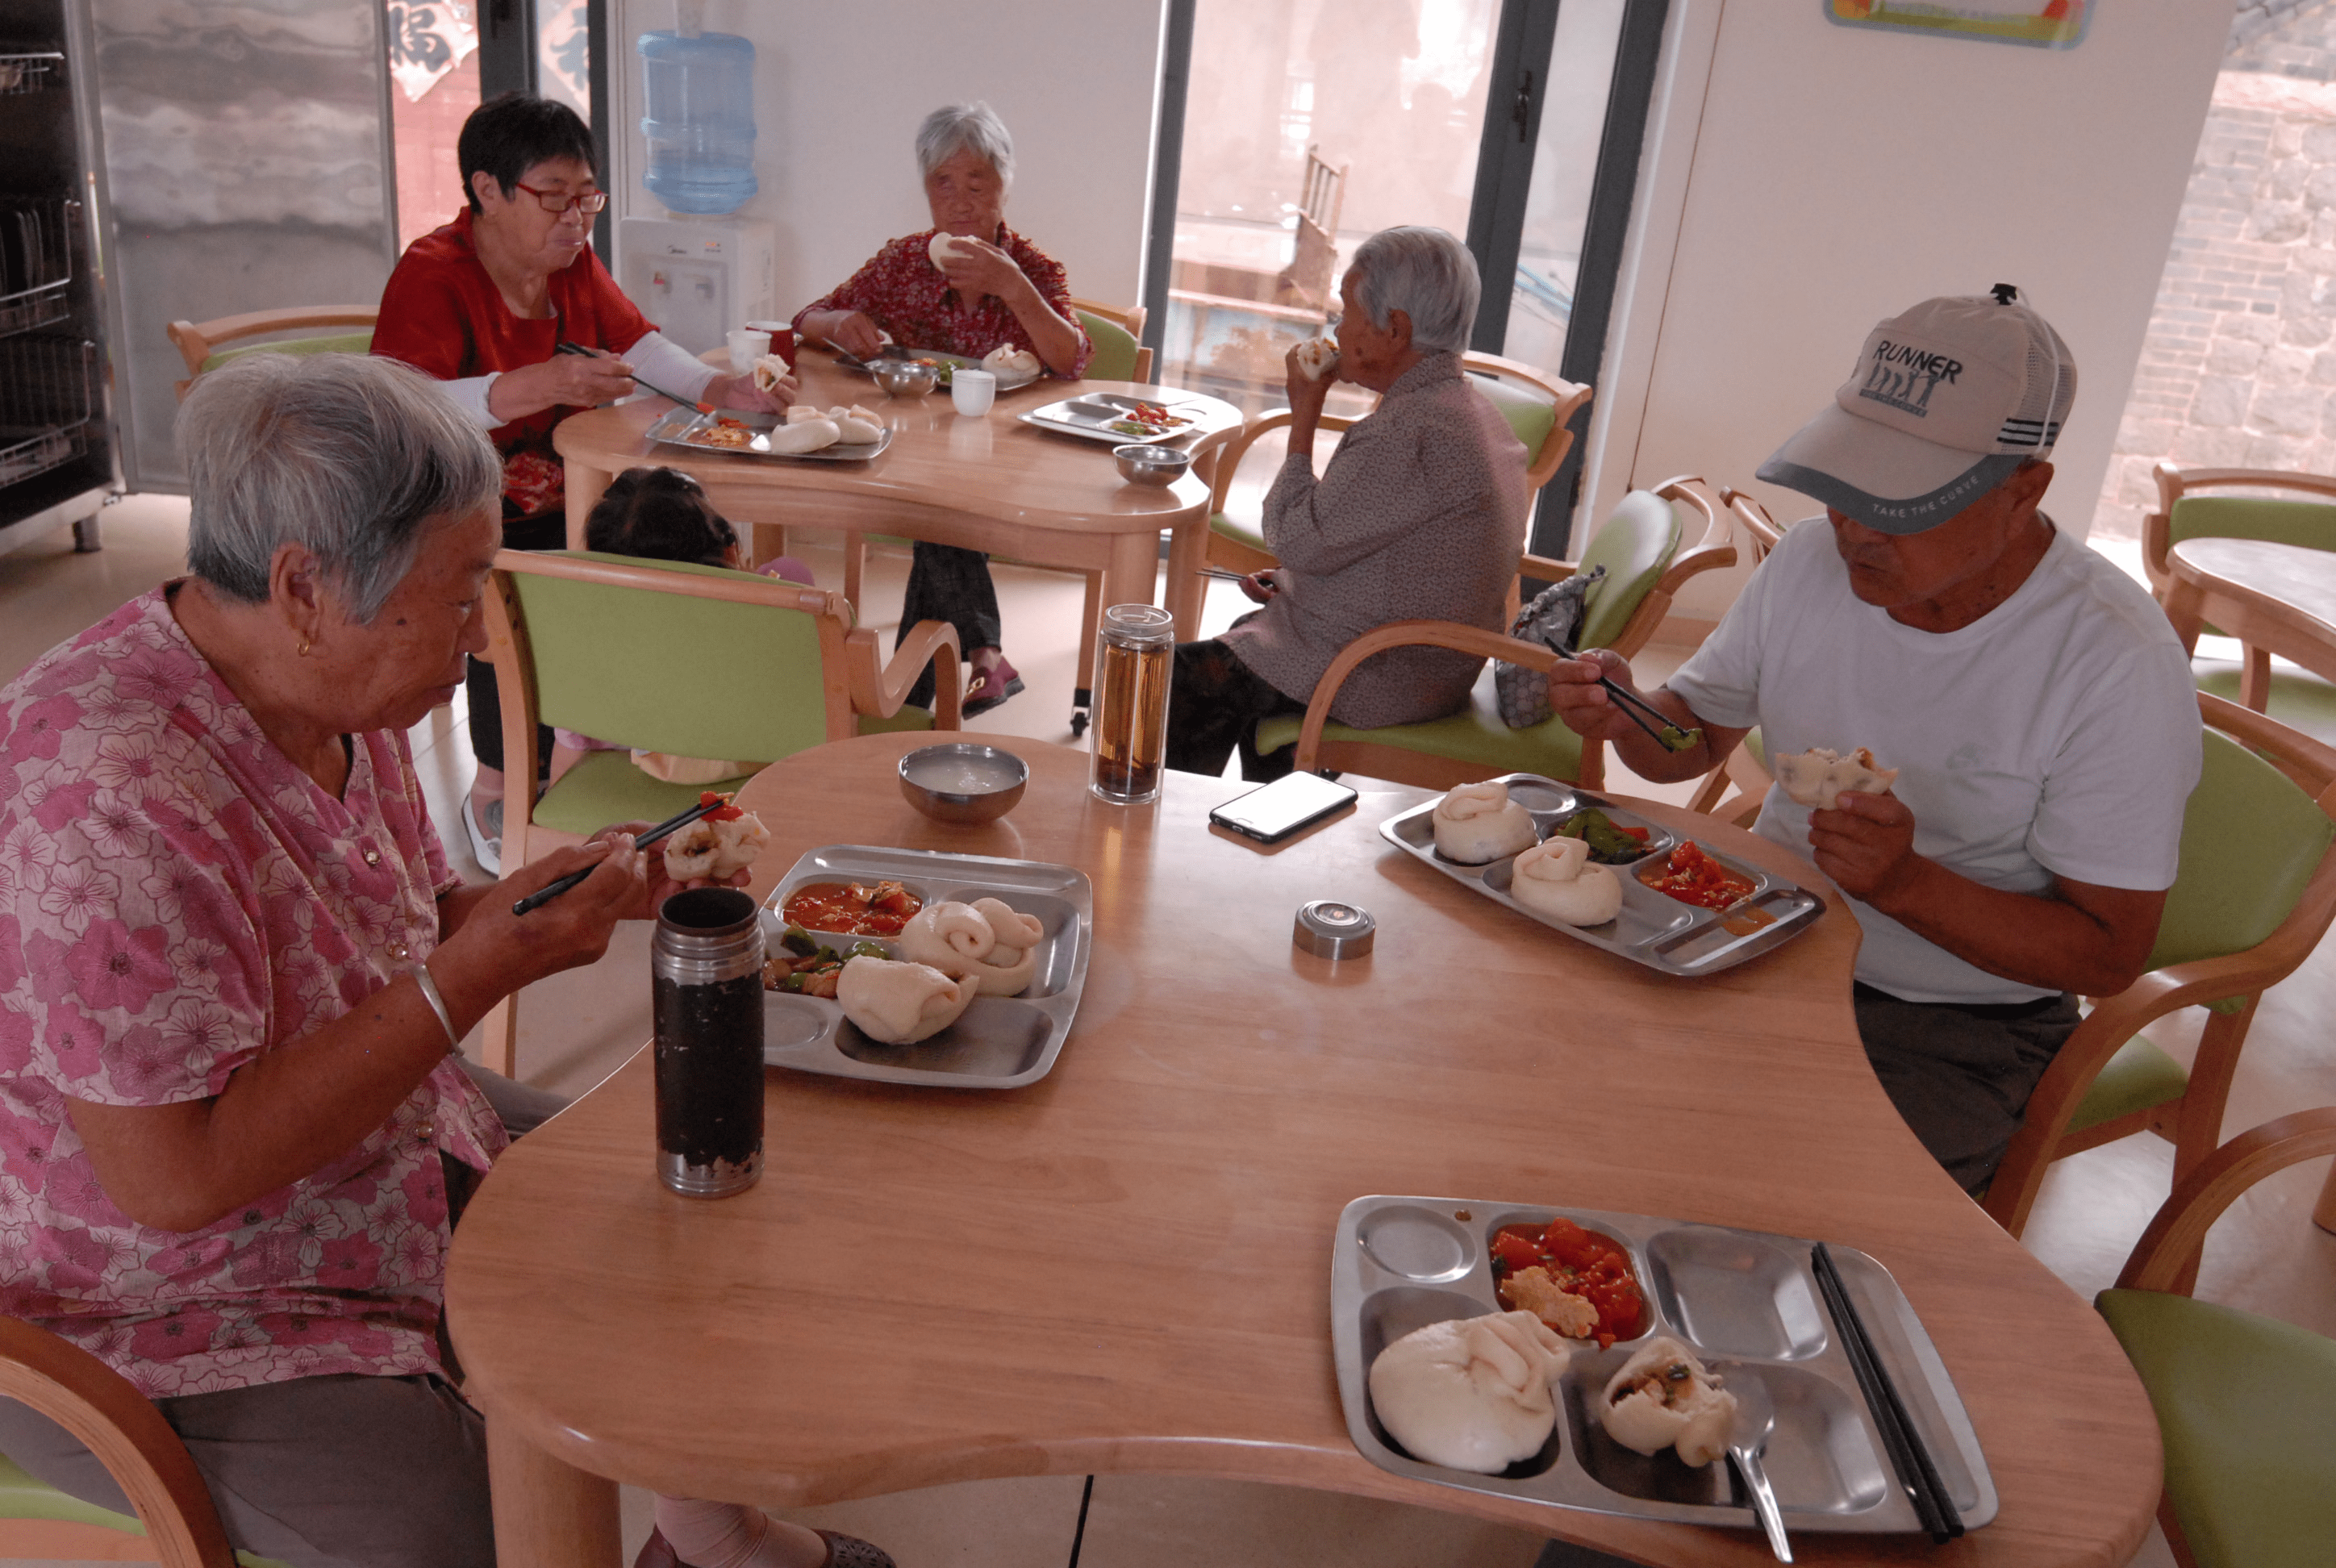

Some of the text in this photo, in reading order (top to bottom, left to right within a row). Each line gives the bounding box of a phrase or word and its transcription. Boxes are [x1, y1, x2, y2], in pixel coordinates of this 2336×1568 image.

[1872, 340, 1963, 385] RUNNER
[1873, 475, 1979, 519] TAKE THE CURVE
